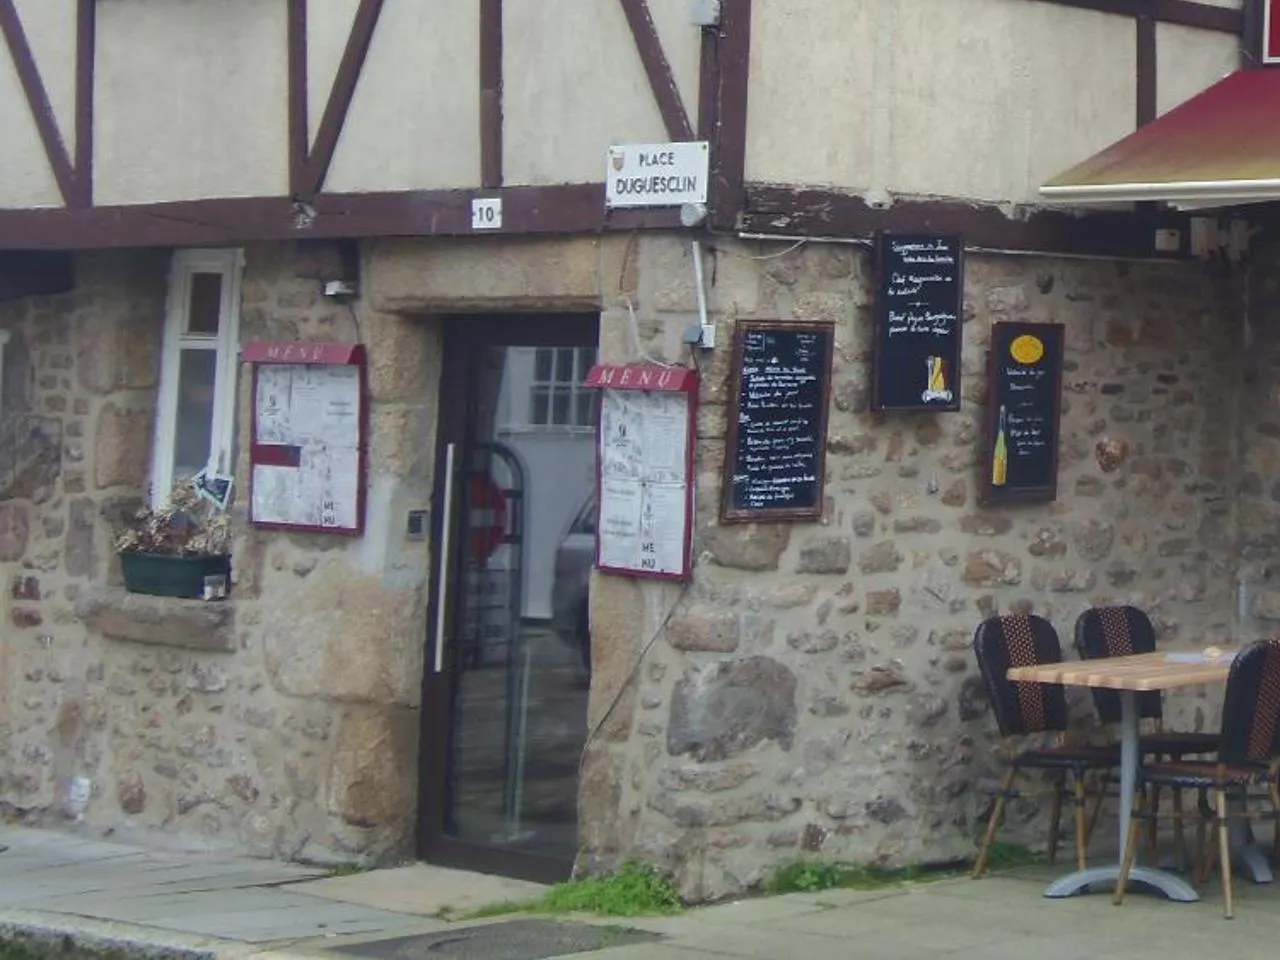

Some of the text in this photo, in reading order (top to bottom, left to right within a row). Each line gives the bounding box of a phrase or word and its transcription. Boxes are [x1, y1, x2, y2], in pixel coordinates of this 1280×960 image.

[639, 152, 675, 167] PLACE
[615, 175, 697, 195] DUGUESCLIN
[478, 206, 494, 222] 10
[597, 367, 672, 388] MENU
